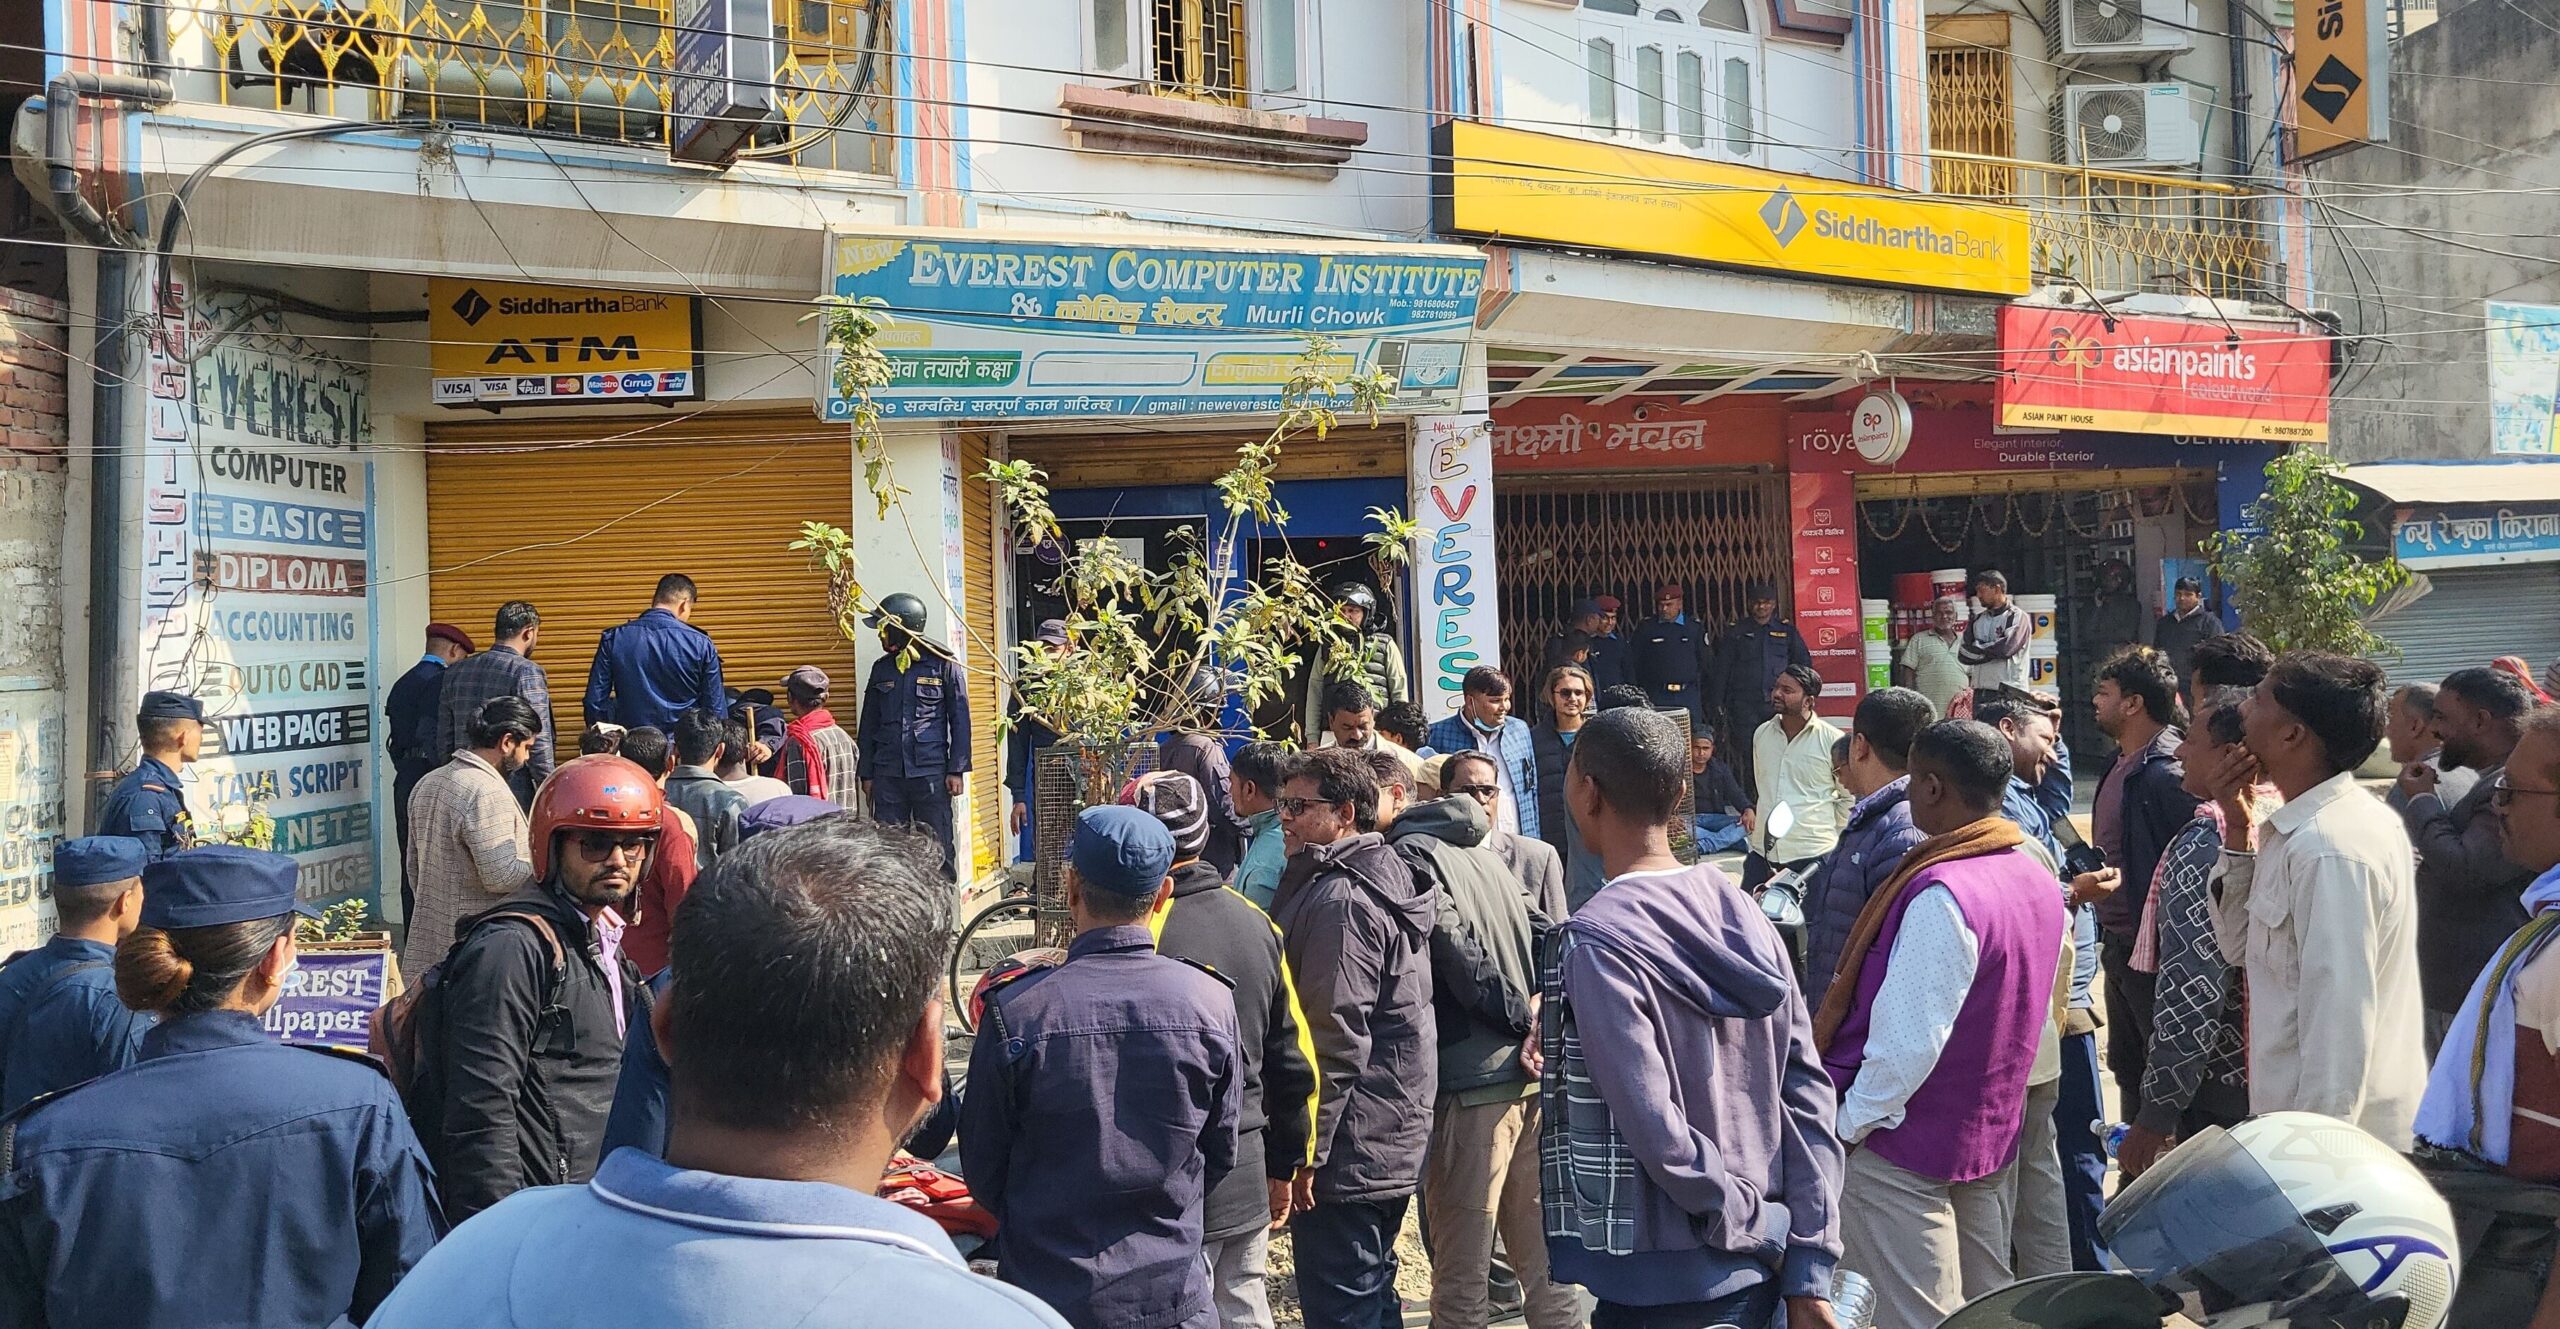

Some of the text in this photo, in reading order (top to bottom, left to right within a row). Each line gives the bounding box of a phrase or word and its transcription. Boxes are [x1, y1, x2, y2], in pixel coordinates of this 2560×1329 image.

[908, 243, 1482, 297] EVEREST COMPUTER INSTITUTE
[1011, 292, 1042, 322] &
[1247, 305, 1386, 325] Murli Chowk
[1413, 299, 1460, 309] 9816806457
[485, 335, 640, 364] ATM
[2113, 336, 2256, 392] asianpaints
[924, 356, 971, 379] तयारी
[976, 361, 1013, 381] कक्षा
[442, 383, 472, 395] VISA
[485, 382, 508, 391] VISA
[525, 385, 545, 394] PLUS
[588, 380, 618, 389] Maestro
[624, 379, 652, 388] Cirrus
[831, 400, 896, 415] Onne
[1025, 399, 1059, 411] काम
[1148, 398, 1186, 414] gmail
[2022, 411, 2094, 424] ASIAN PAINT HOUSE
[1974, 438, 2018, 450] Elegant
[2000, 451, 2095, 462] Durable Exterior
[211, 446, 347, 493] COMPUTER
[232, 502, 334, 542] BASIC
[218, 554, 351, 592] DIPLOMA
[1429, 437, 1479, 712] EVERES
[213, 610, 354, 642] ACCOUNTING
[229, 662, 341, 695] AUTO CAD
[221, 711, 342, 751] WEB PAGE
[289, 759, 363, 798] SCRIPT
[286, 968, 369, 997] REST
[2197, 980, 2215, 1000] ITALIA
[264, 1004, 365, 1039] llpaper
